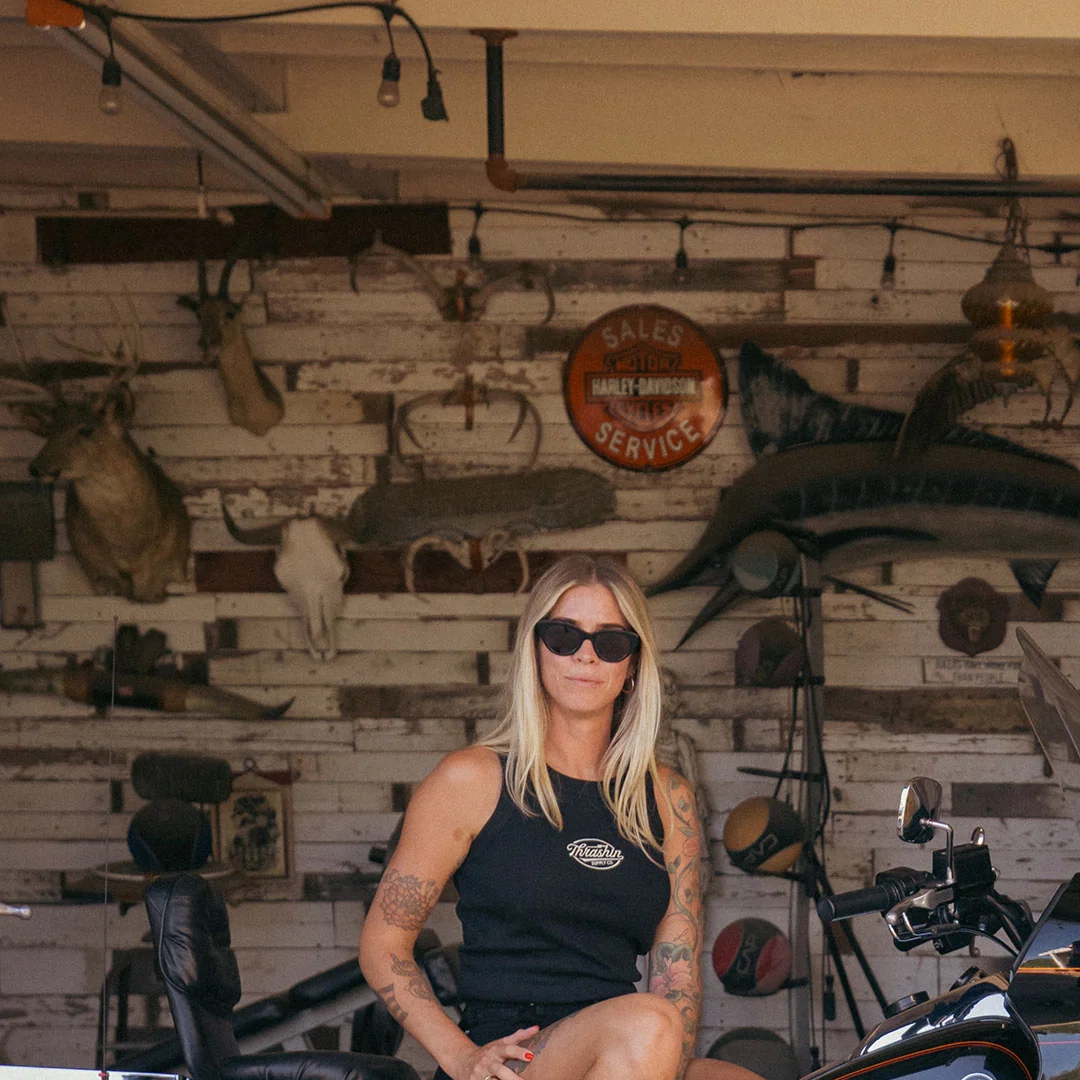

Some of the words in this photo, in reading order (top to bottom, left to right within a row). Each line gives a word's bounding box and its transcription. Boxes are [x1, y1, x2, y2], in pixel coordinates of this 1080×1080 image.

[601, 319, 684, 348] SALES
[592, 377, 696, 396] HARLEY-DAVIDSON
[595, 419, 701, 460] SERVICE
